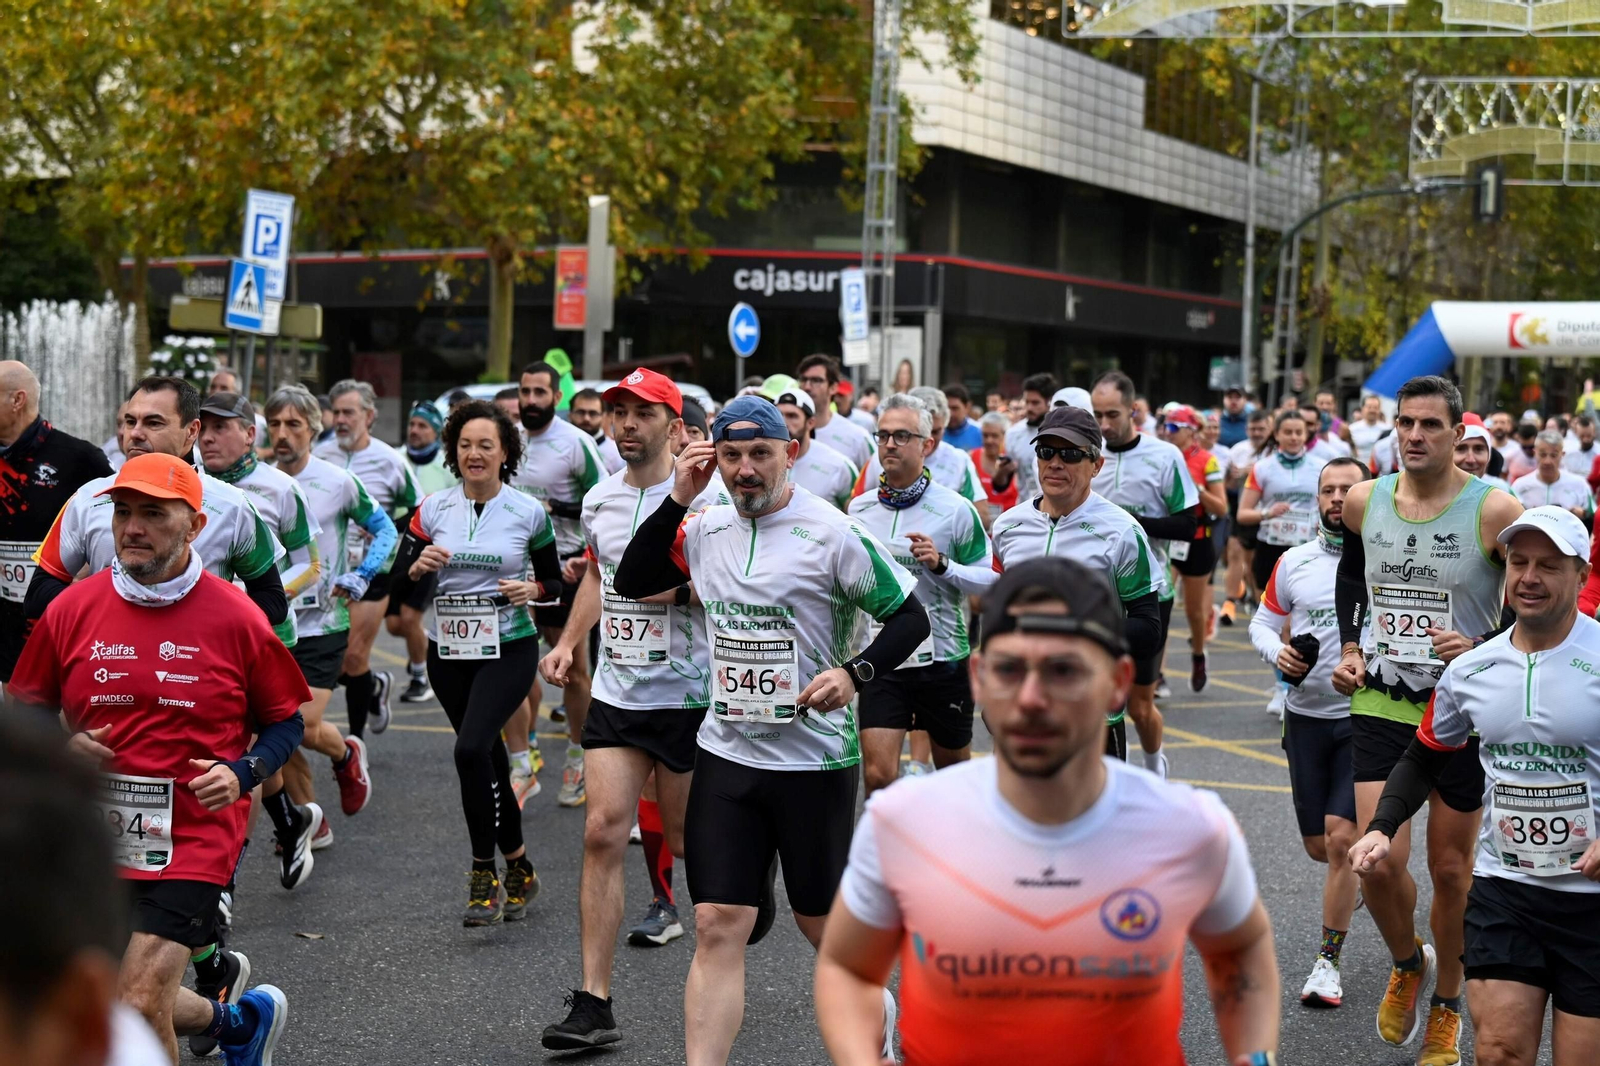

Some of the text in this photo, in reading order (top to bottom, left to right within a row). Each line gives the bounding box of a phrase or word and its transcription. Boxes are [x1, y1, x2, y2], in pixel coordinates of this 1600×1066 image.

[256, 217, 279, 254] P
[734, 263, 839, 296] cajasur
[502, 503, 514, 514] SIG
[921, 503, 934, 513] SIG
[1532, 513, 1559, 522] KIPRUN
[790, 526, 810, 540] SIG
[1079, 521, 1095, 534] SIG
[452, 553, 503, 564] SUBIDA
[460, 563, 500, 573] ERMITAS
[1381, 558, 1438, 582] iberGrafic
[1382, 588, 1402, 597] SUBIDA
[704, 600, 796, 619] XII SUBIDA
[1307, 609, 1324, 619] XII
[448, 619, 482, 639] 407
[610, 617, 651, 641] 537
[717, 619, 739, 631] LAS
[1317, 619, 1334, 628] LAS
[1385, 612, 1432, 638] 329
[100, 644, 135, 656] califas
[723, 640, 741, 648] SUBIDA
[760, 642, 790, 650] ERMITAS
[729, 650, 755, 660] DONACIÓN
[763, 652, 792, 660] ORGANOS
[1569, 658, 1592, 673] SIG
[725, 666, 776, 695] 546
[100, 695, 134, 703] IMDECO
[158, 697, 196, 708] hymcor
[1484, 742, 1588, 759] XII SUBIDA
[1498, 761, 1522, 771] LAS
[1524, 761, 1587, 774] ERMITAS
[116, 783, 130, 791] LAS
[131, 784, 164, 793] ERMITAS
[1504, 787, 1527, 797] SUBIDA
[1534, 789, 1548, 797] LAS
[1549, 786, 1582, 796] ERMITAS
[125, 793, 133, 803] DE
[134, 794, 166, 804] ORGANOS
[1507, 797, 1514, 805] LA
[1554, 796, 1586, 807] ORGANOS
[1511, 816, 1570, 846] 389
